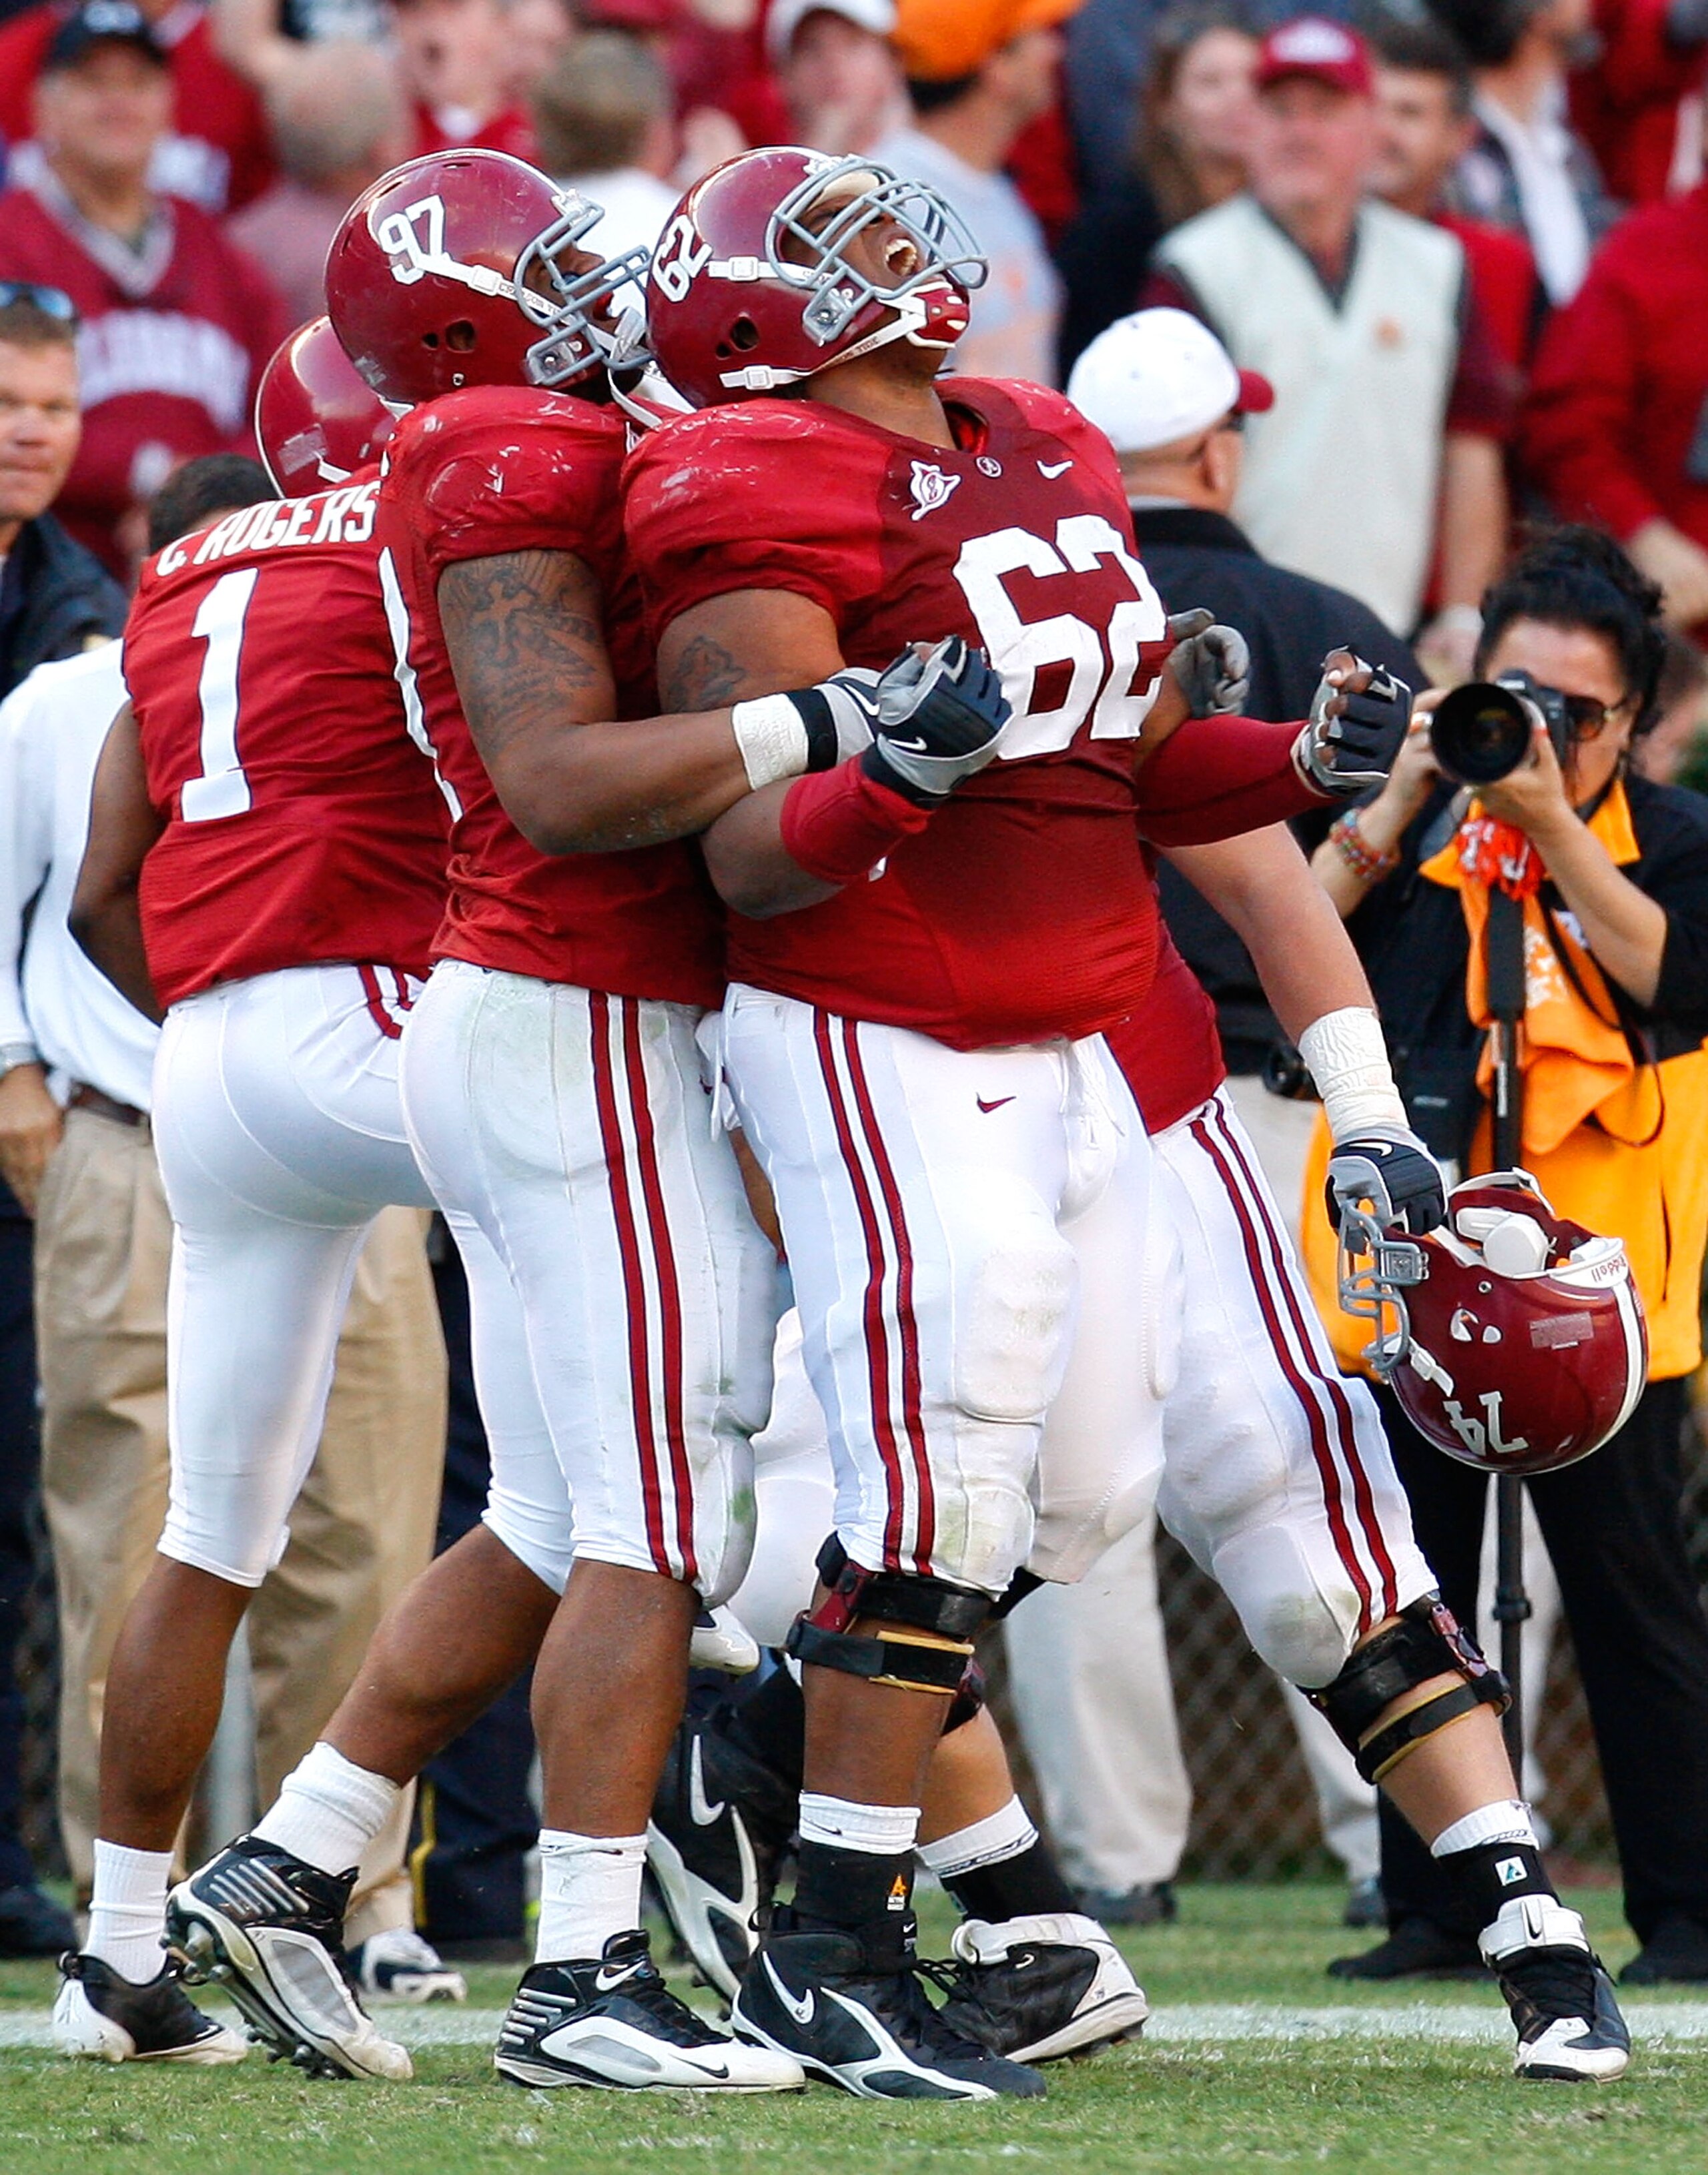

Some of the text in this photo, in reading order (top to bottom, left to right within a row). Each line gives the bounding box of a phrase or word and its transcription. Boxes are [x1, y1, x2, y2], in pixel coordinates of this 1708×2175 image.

[378, 194, 445, 285] 97
[651, 214, 713, 302] 62
[193, 480, 382, 565] ROGERS
[952, 514, 1166, 760] 62
[181, 567, 258, 823] 1
[1442, 1390, 1529, 1456] 74
